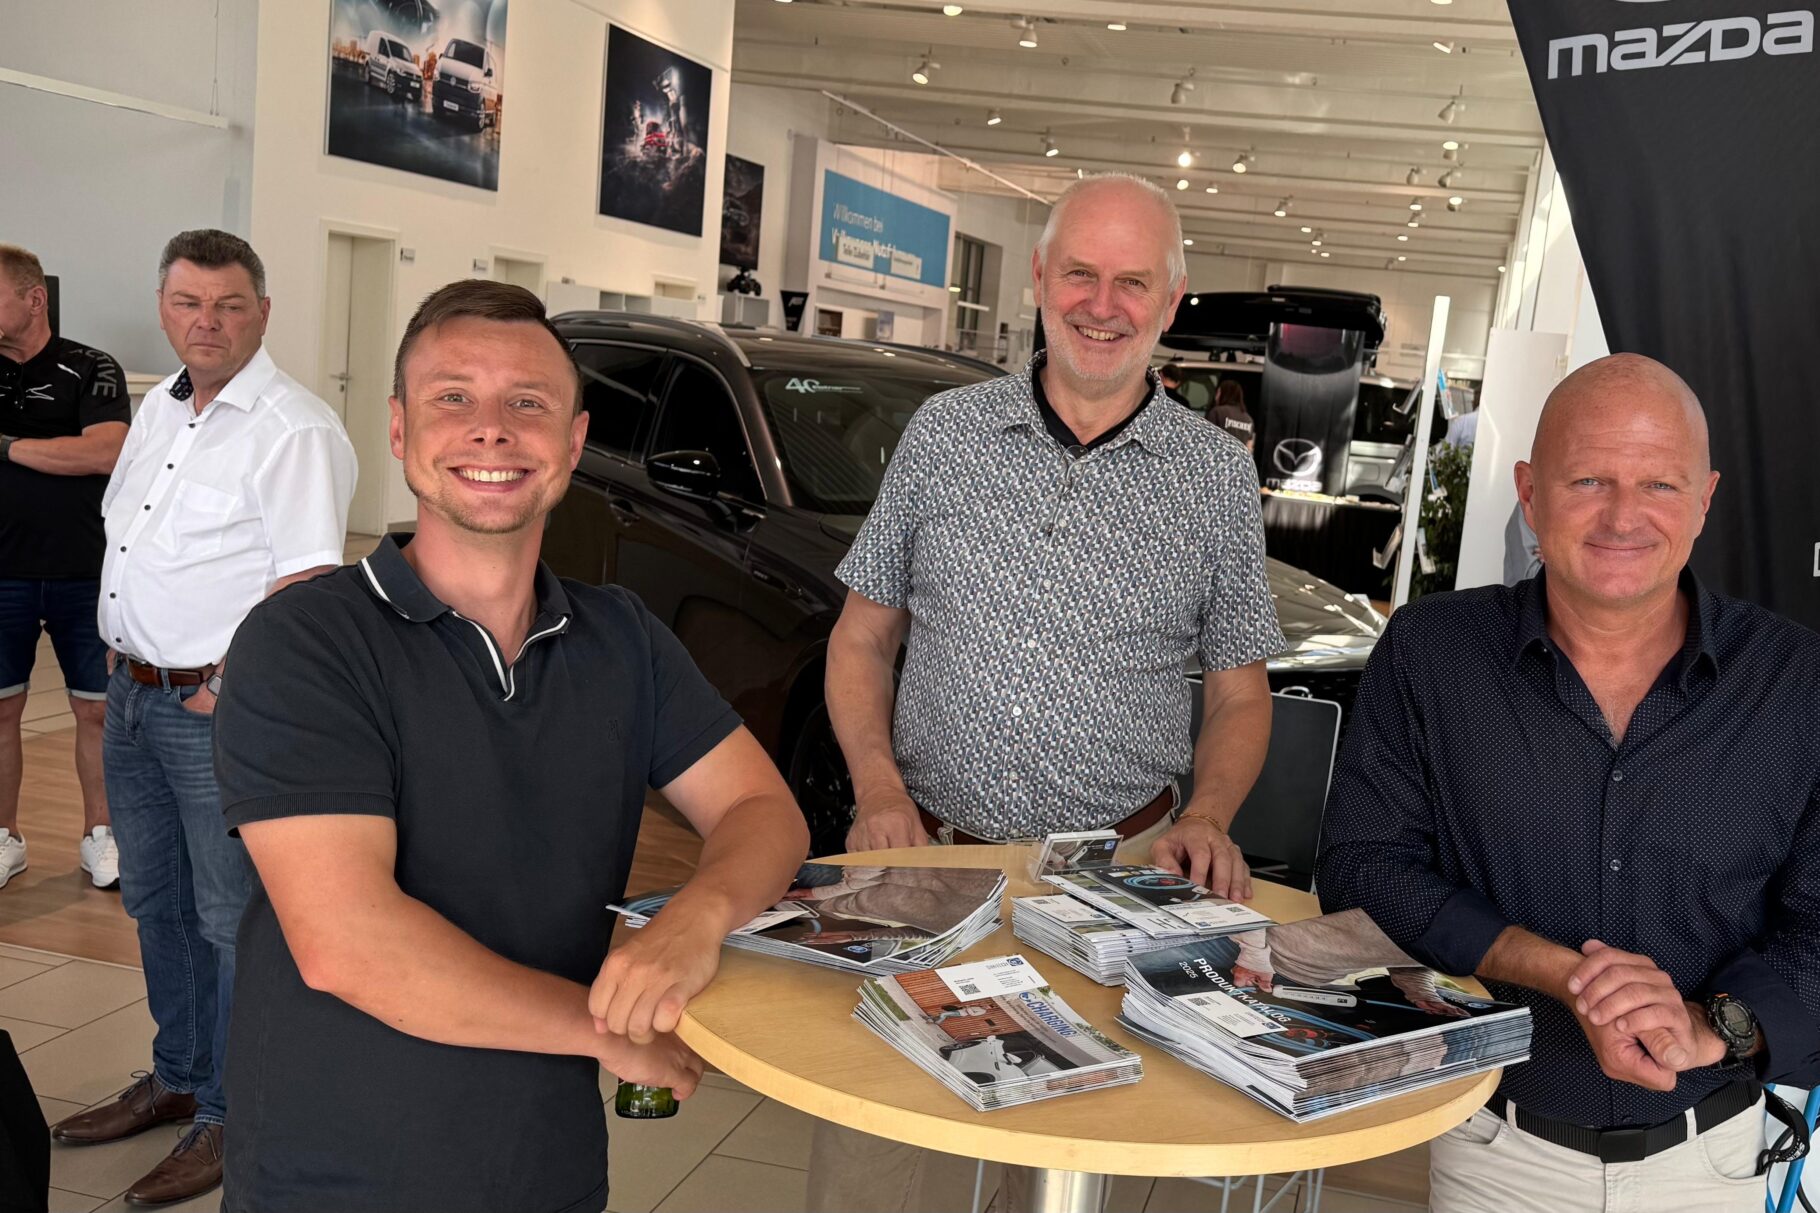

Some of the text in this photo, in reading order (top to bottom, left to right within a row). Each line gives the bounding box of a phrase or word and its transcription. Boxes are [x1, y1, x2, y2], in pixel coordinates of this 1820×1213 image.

[1547, 9, 1815, 80] mazda
[1178, 961, 1199, 979] 2025
[1193, 957, 1292, 1023] PRODUKTKATALOG
